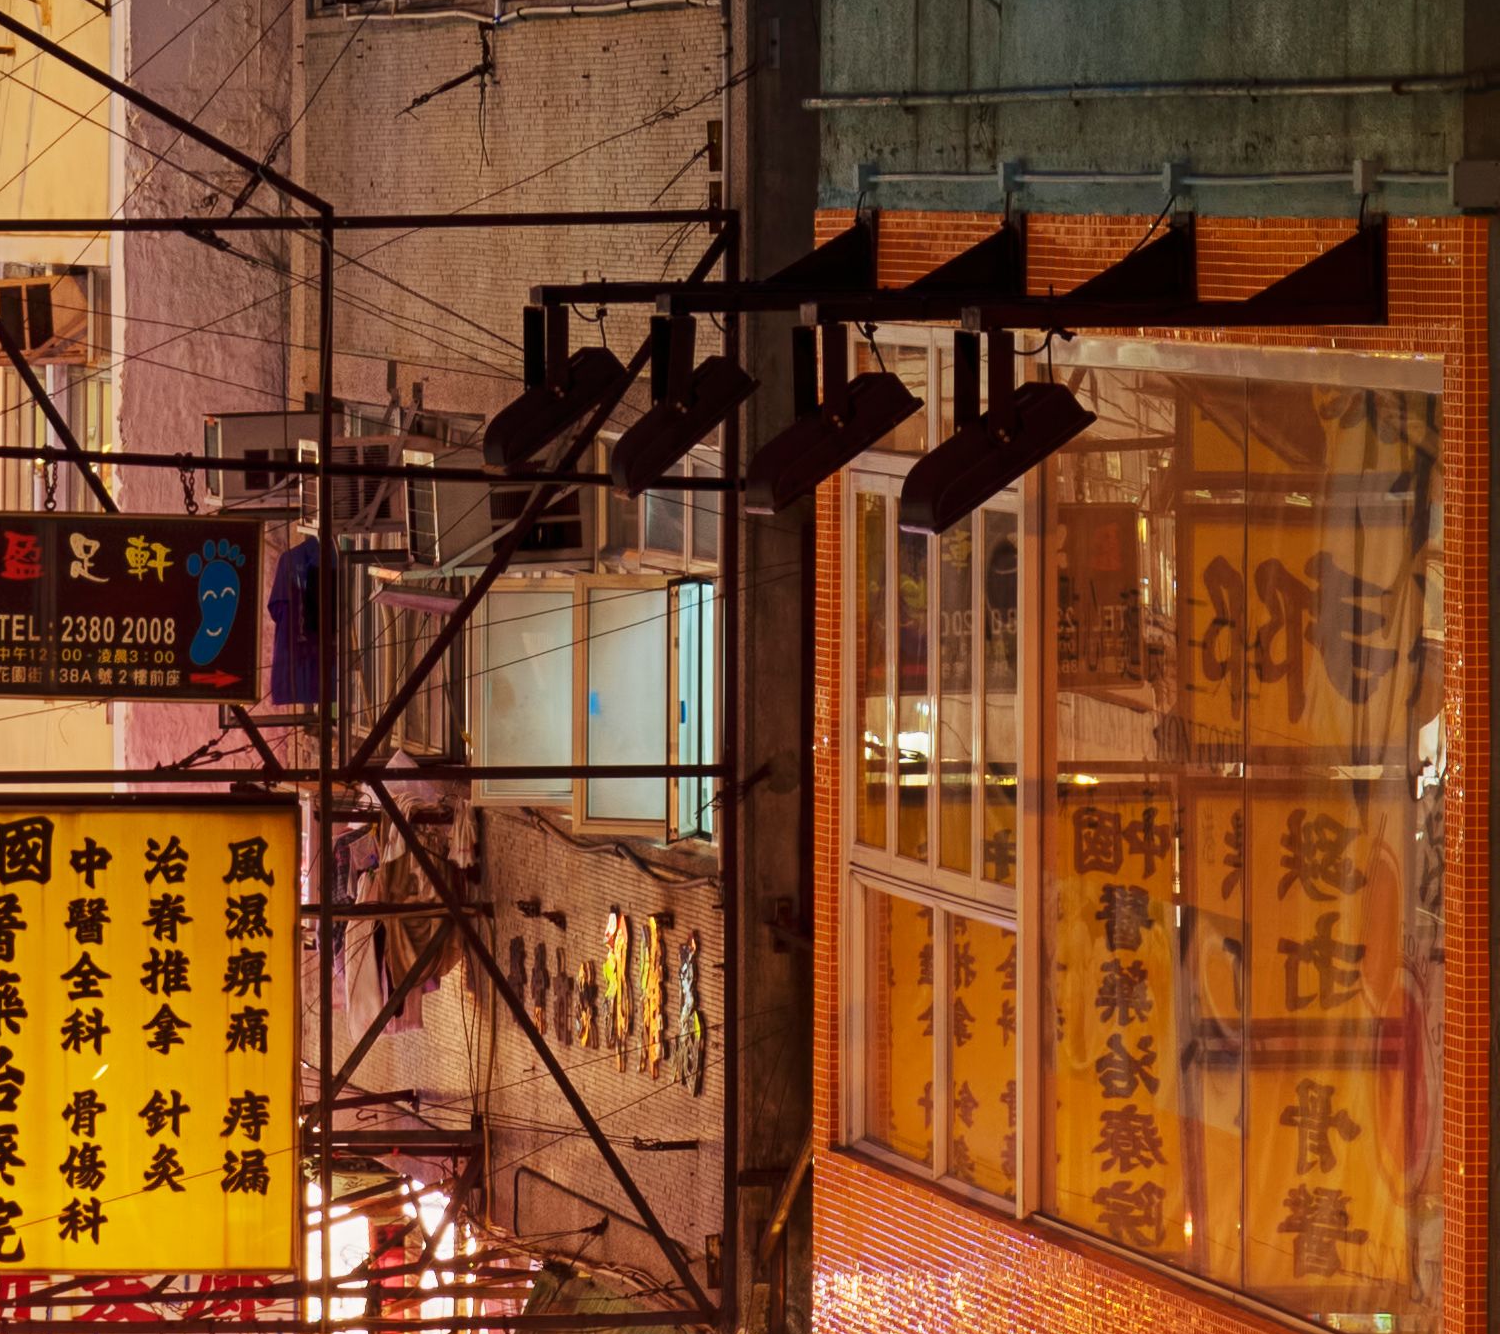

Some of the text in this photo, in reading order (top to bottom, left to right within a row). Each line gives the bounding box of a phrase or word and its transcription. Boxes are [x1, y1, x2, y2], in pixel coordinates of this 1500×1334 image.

[0, 530, 174, 582] 盈足軒
[61, 617, 115, 644] 2380
[121, 617, 176, 645] 2008
[57, 837, 113, 1245] 中醫全科 骨傷科
[138, 837, 193, 1194] 治脊推拿 針灸
[219, 1091, 272, 1196] 痔漏
